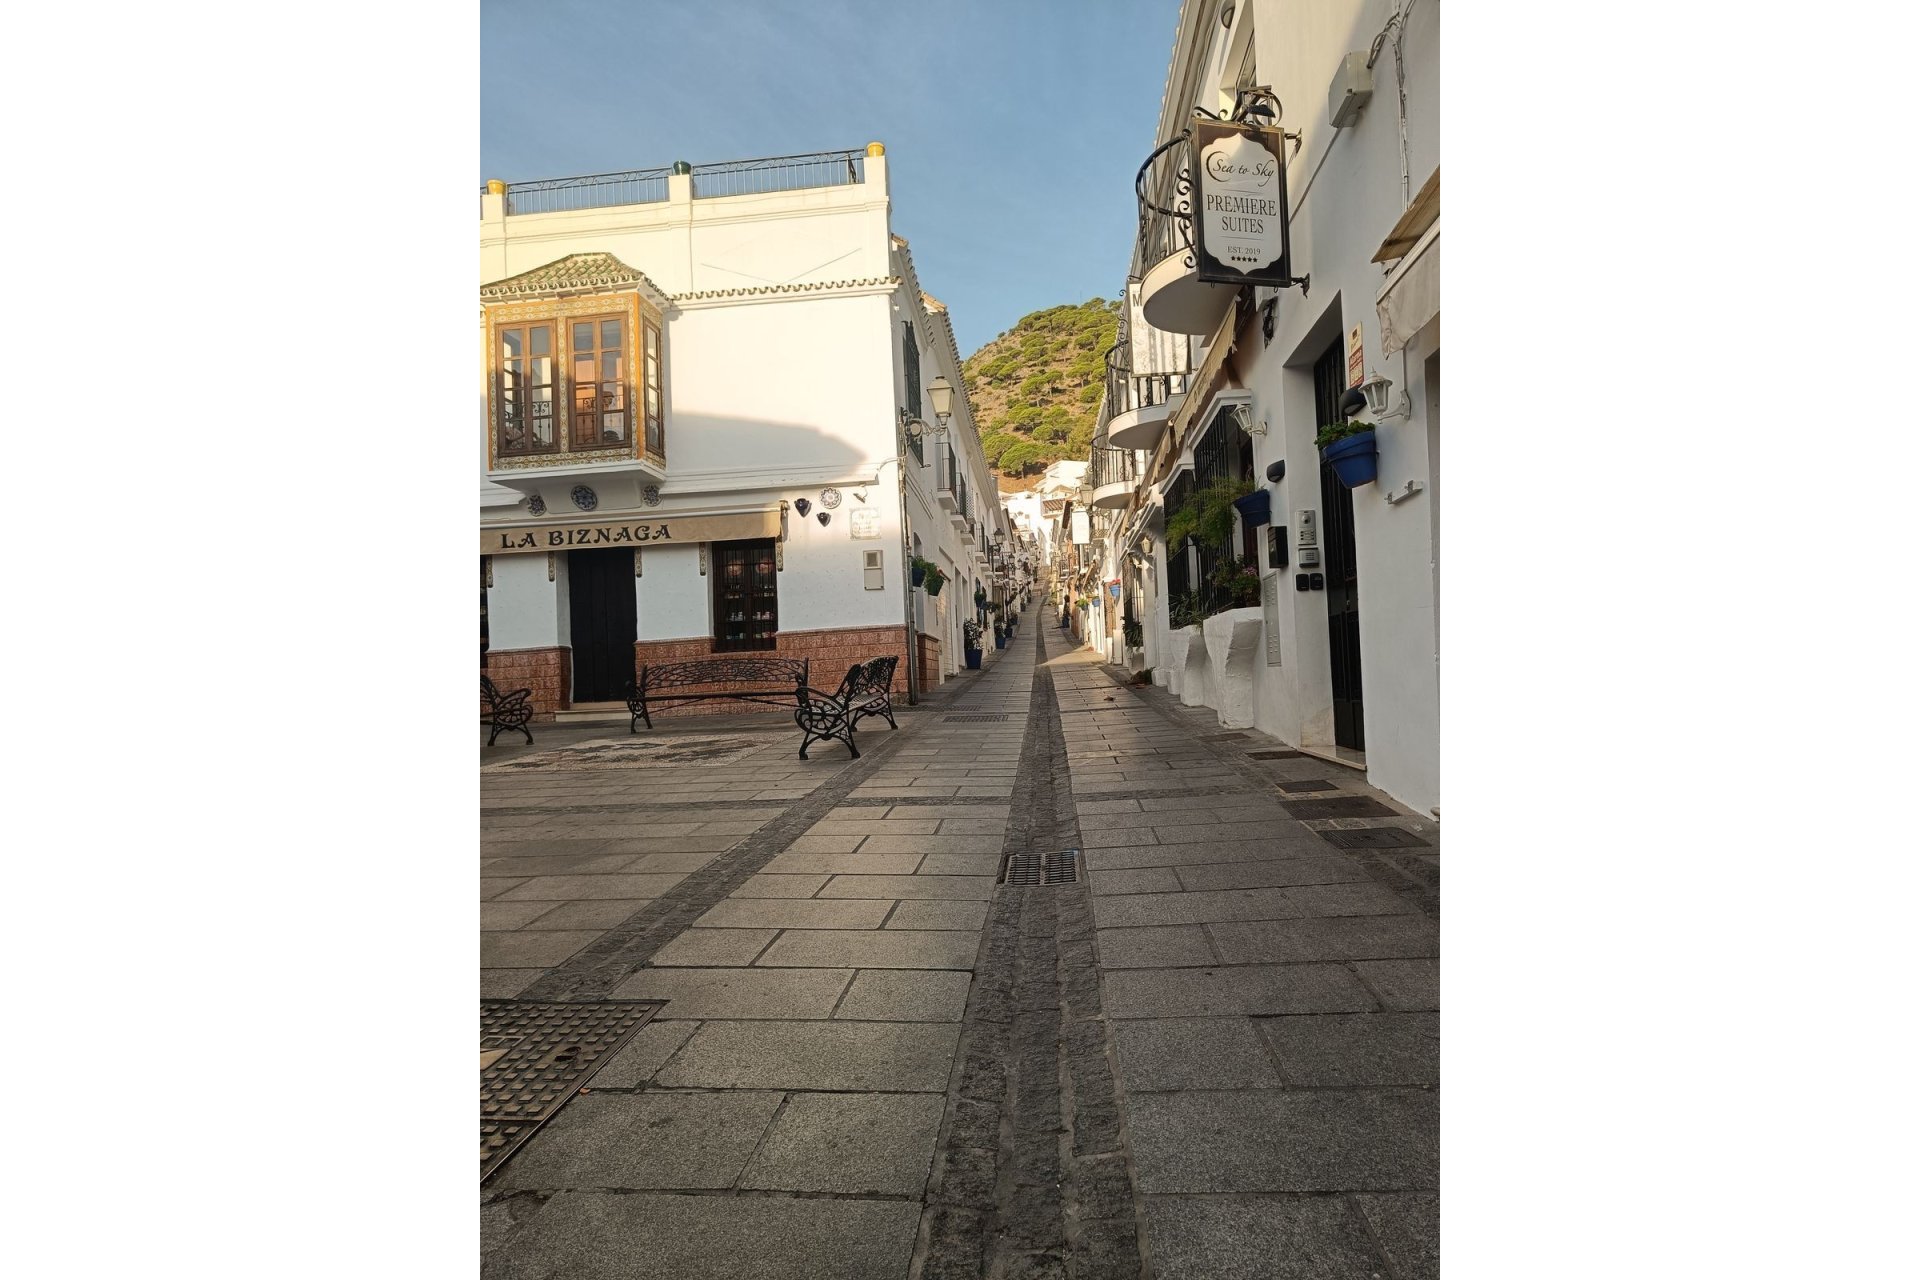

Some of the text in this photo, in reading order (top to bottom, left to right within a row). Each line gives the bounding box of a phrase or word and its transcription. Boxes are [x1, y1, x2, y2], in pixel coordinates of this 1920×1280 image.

[1212, 159, 1275, 188] Sea to Sky
[1206, 194, 1277, 217] PREMIERE
[1221, 216, 1264, 234] SUITES
[1245, 247, 1261, 255] 2019
[501, 524, 672, 549] LA BIZNAGA
